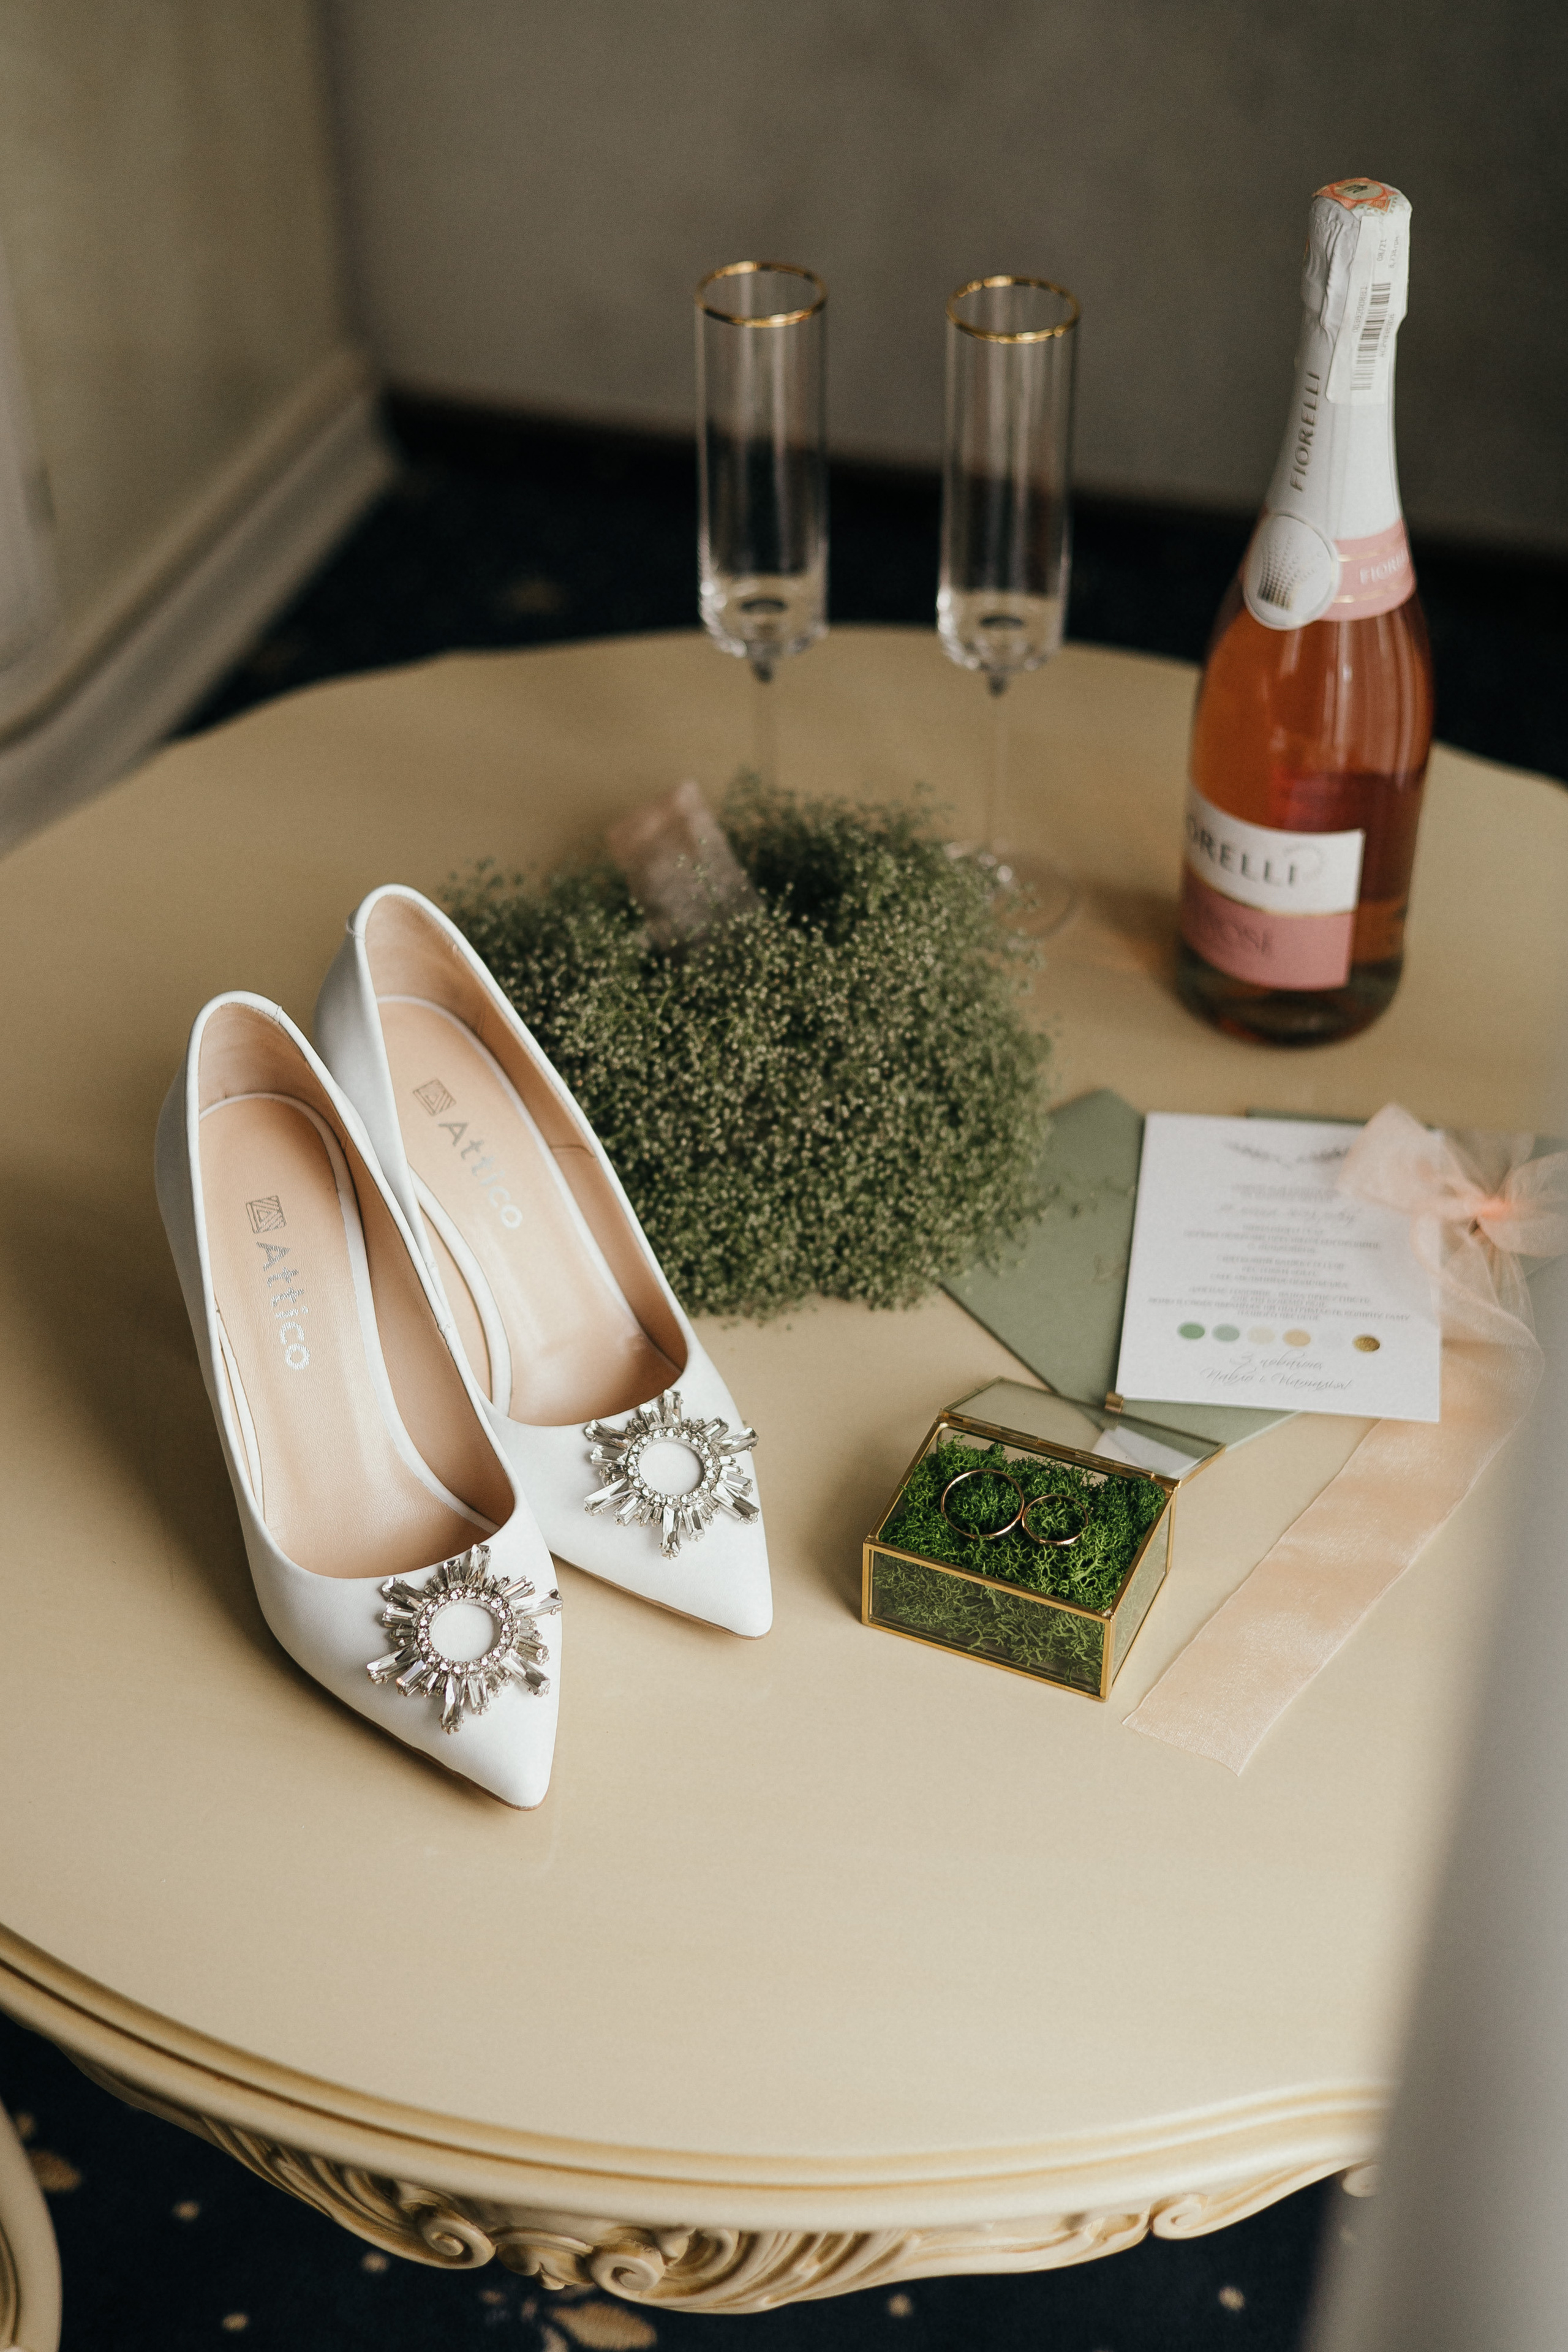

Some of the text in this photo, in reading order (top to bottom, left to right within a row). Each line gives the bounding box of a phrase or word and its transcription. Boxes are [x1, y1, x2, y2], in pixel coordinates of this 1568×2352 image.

[1290, 371, 1320, 492] FIORELLI
[438, 1121, 523, 1229] Attico
[256, 1240, 311, 1371] Attico
